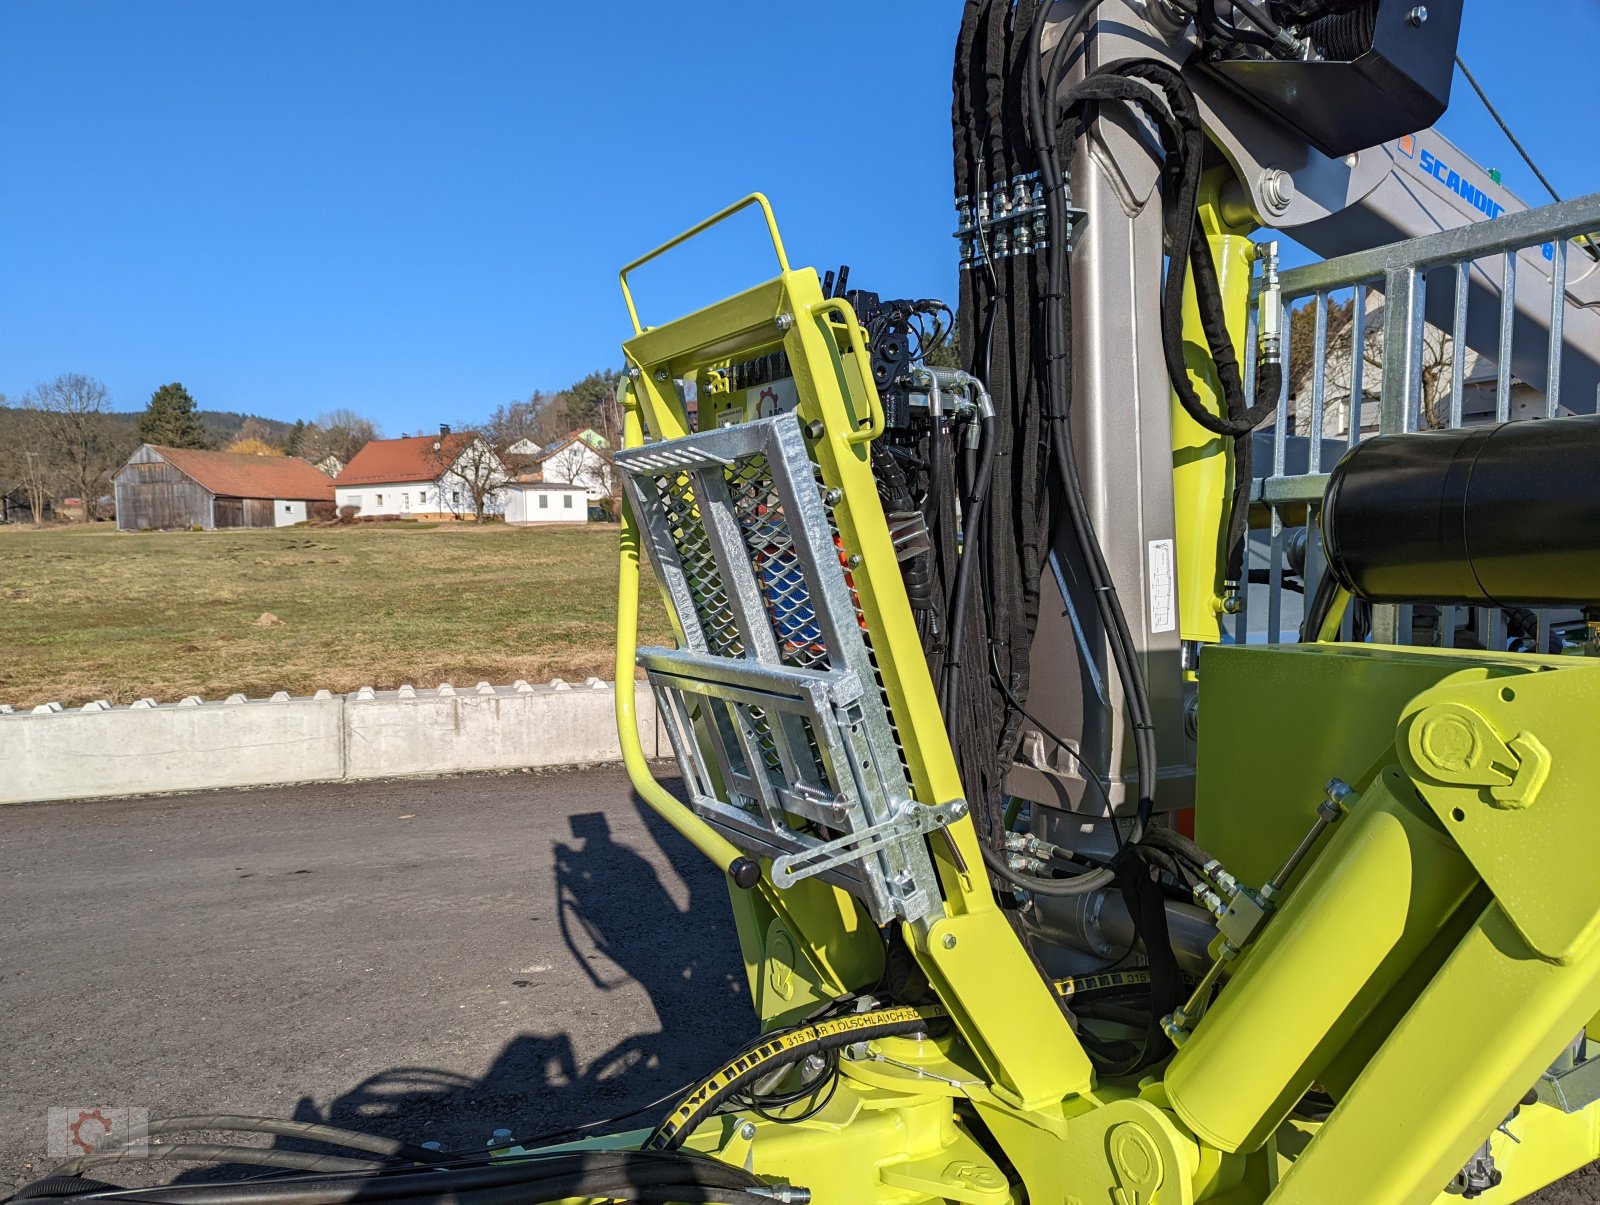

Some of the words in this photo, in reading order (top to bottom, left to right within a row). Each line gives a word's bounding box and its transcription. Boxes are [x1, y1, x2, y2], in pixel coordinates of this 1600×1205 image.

[1127, 973, 1147, 983] 315
[786, 1033, 805, 1047] 315
[830, 1023, 836, 1033] 1
